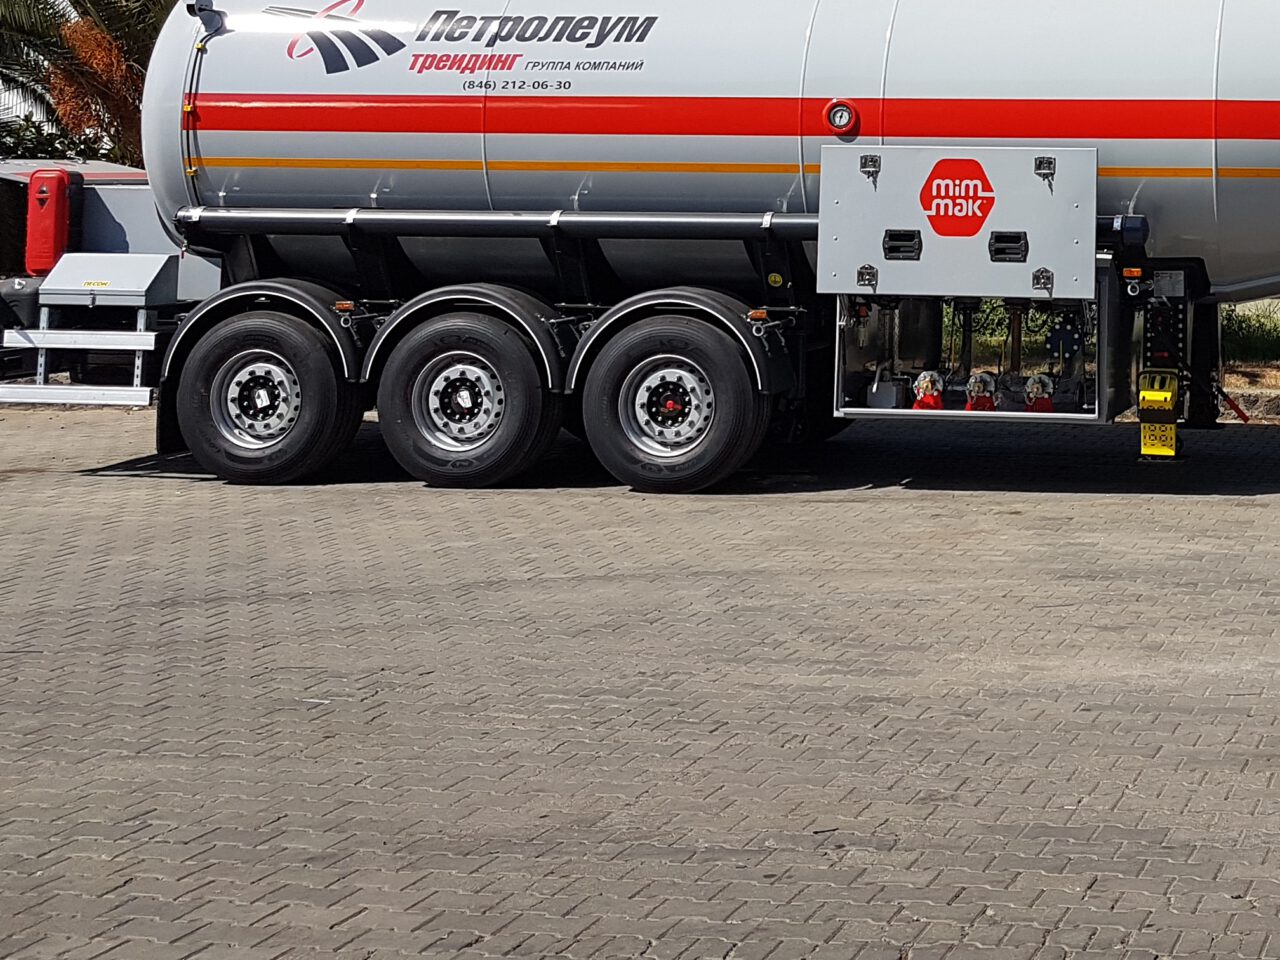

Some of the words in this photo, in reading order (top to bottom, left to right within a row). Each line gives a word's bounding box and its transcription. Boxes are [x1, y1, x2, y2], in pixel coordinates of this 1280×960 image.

[414, 10, 659, 48] Петролеум
[525, 61, 572, 71] ГРУППА
[574, 60, 644, 71] КОМПАНИЙ
[462, 79, 497, 91] (846)
[501, 80, 571, 90] 212-06-30
